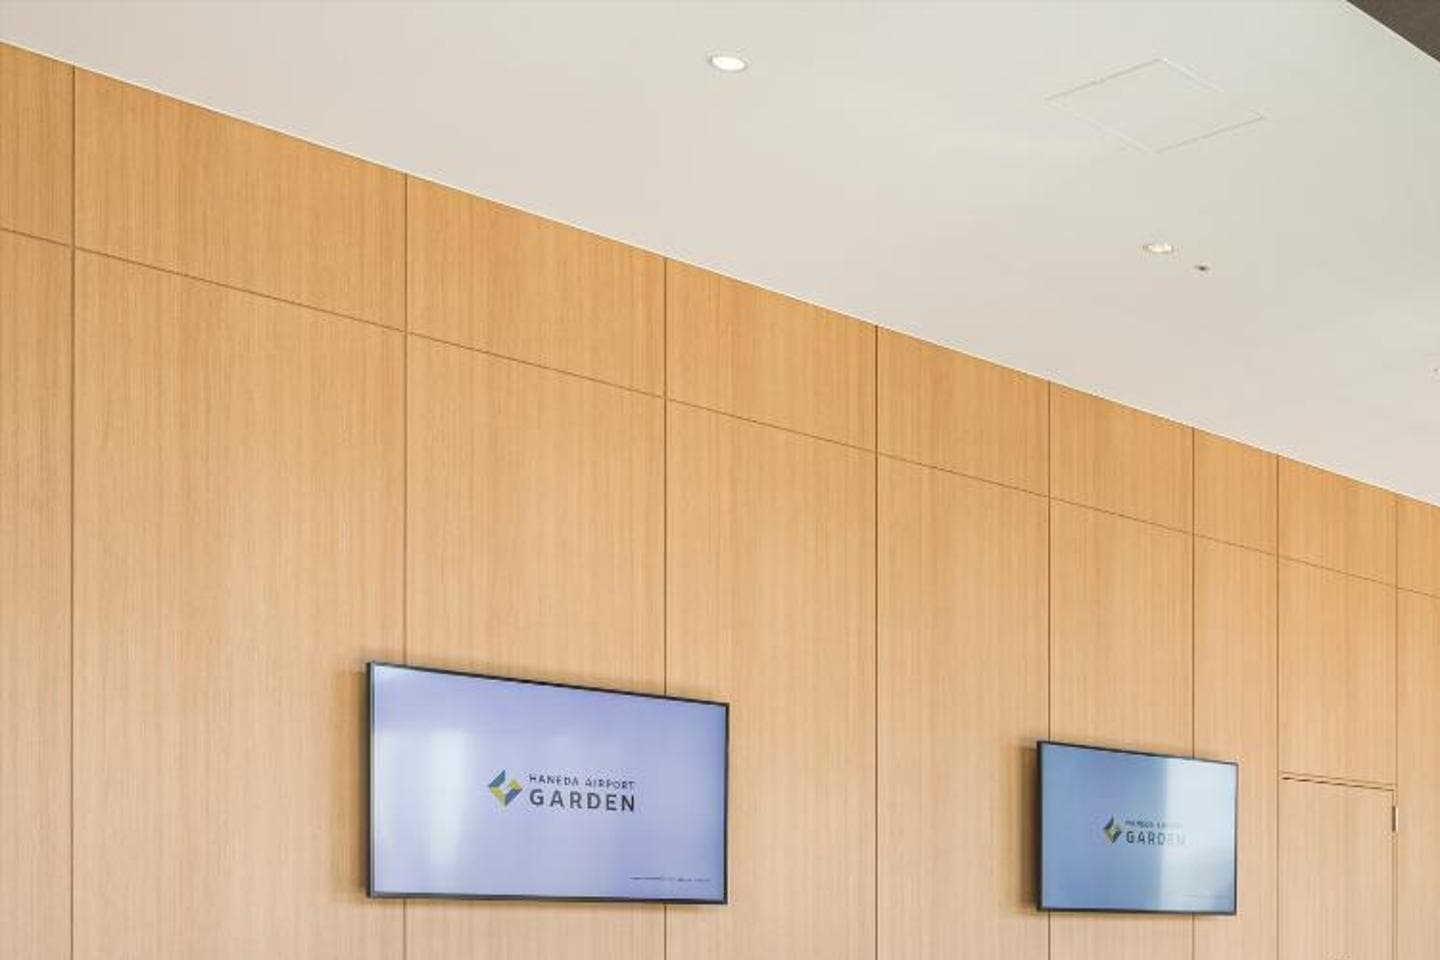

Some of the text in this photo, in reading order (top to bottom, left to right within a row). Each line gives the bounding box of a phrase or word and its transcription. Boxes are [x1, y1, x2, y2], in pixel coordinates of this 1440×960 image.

[529, 773, 636, 790] HANEDA AIRPORT
[529, 788, 635, 812] GARDEN
